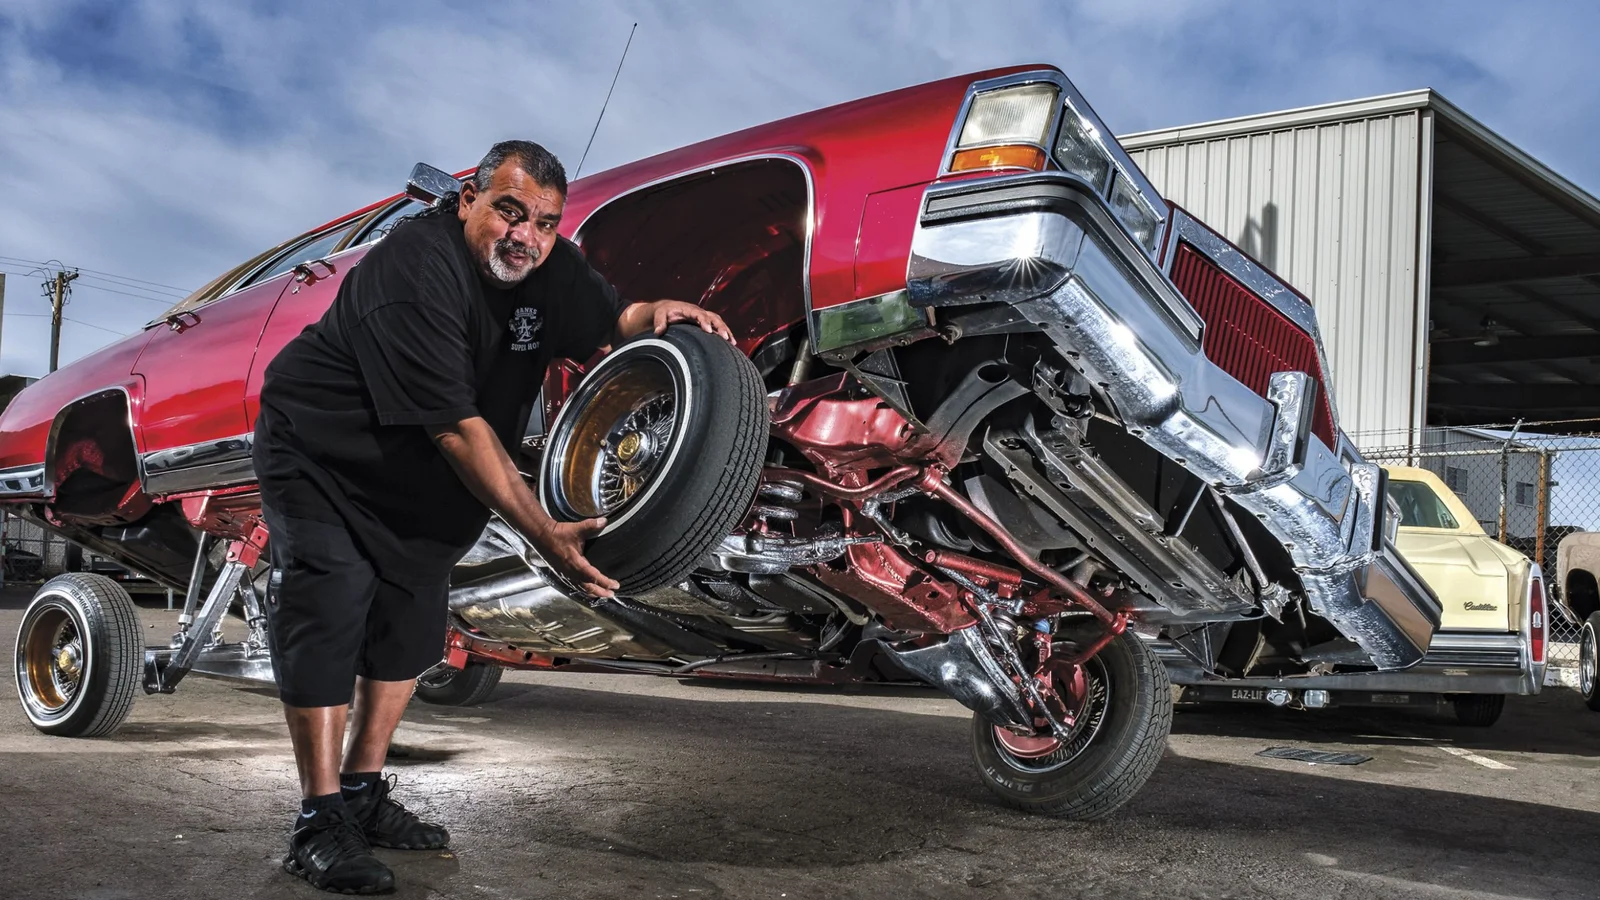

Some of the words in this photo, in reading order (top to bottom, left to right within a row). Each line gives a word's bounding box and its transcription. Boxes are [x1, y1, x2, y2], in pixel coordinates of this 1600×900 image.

[511, 343, 527, 351] SUPER
[70, 588, 96, 633] REMINGTO
[1463, 600, 1498, 611] Cadillac
[1231, 689, 1266, 700] EAZ-LIF
